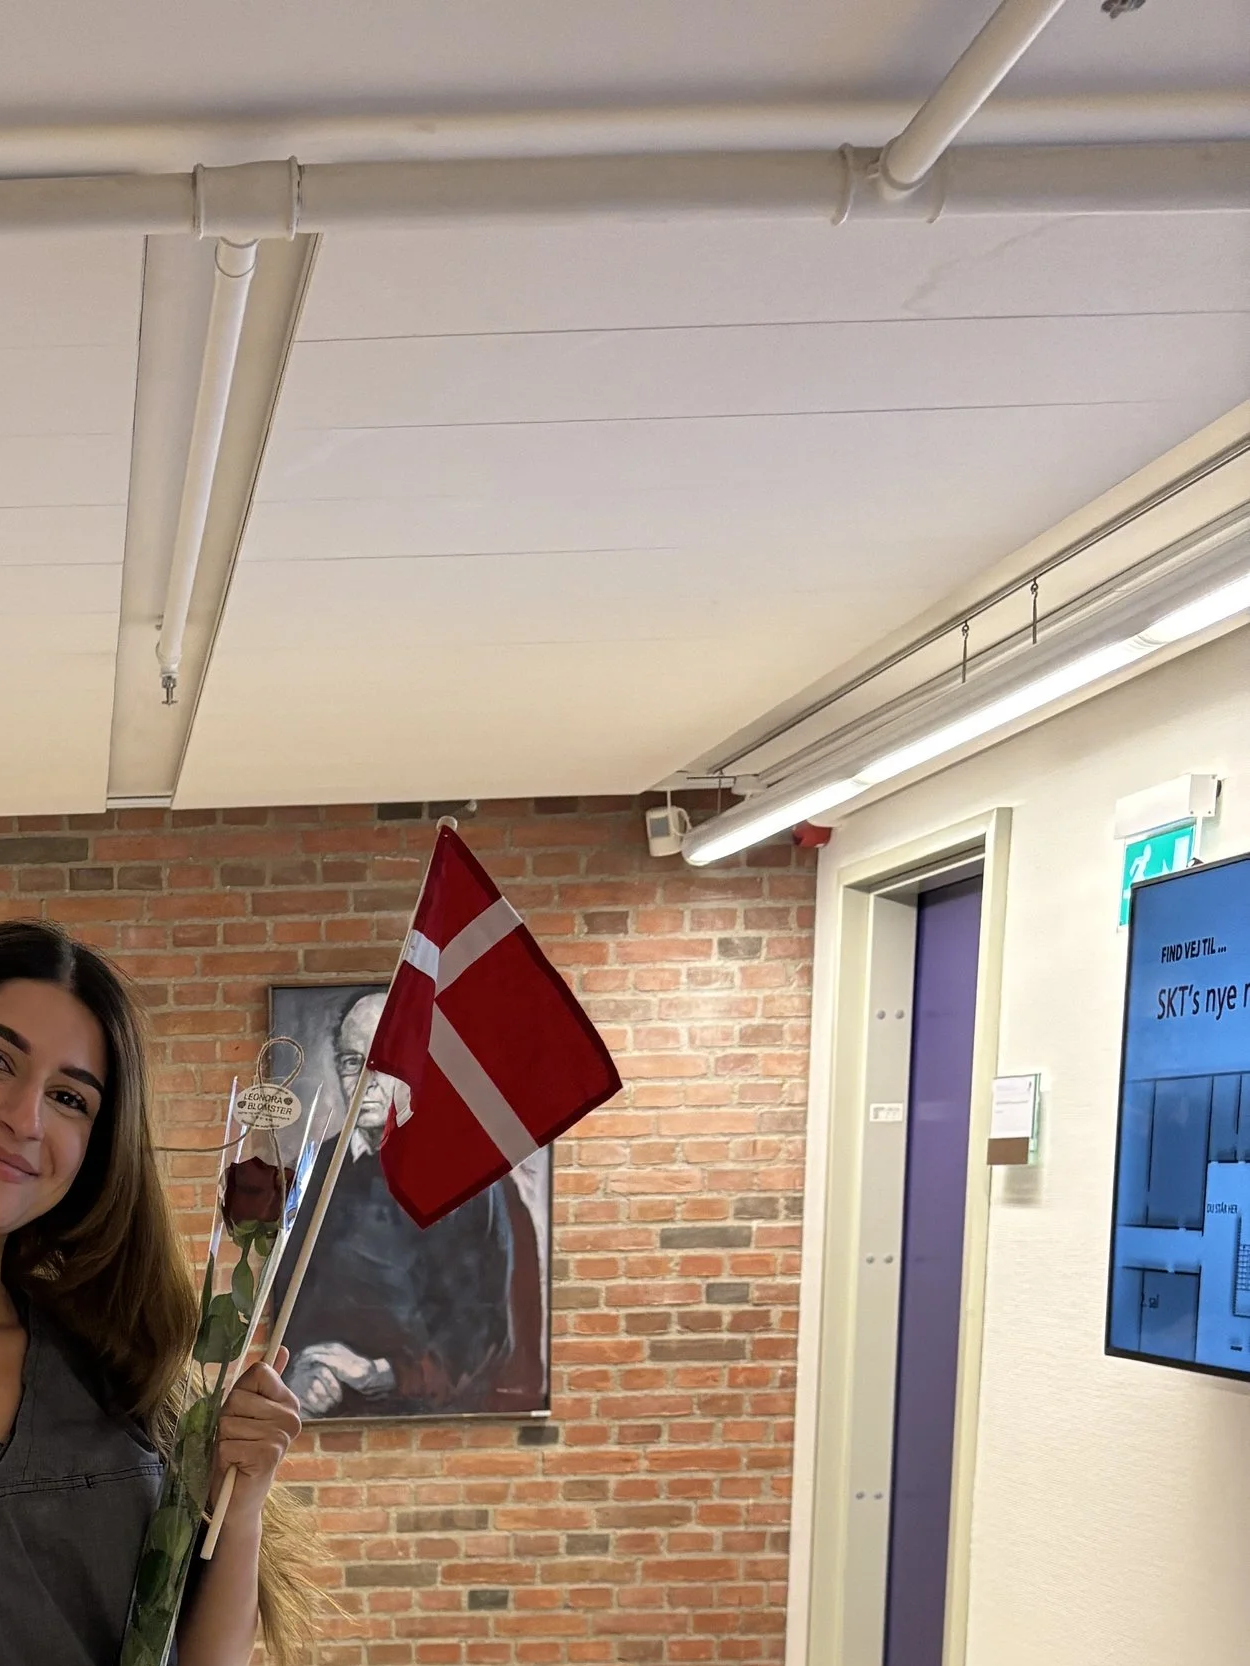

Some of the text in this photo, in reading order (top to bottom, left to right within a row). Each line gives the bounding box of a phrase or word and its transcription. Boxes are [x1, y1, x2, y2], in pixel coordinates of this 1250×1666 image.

[1161, 943, 1183, 964] FIND
[1184, 939, 1201, 960] VEJ
[1202, 936, 1216, 956] TIL
[1157, 984, 1200, 1020] SKT's
[1205, 985, 1237, 1021] nye
[243, 1093, 283, 1105] LEONORA
[247, 1102, 293, 1116] BLOMSTER
